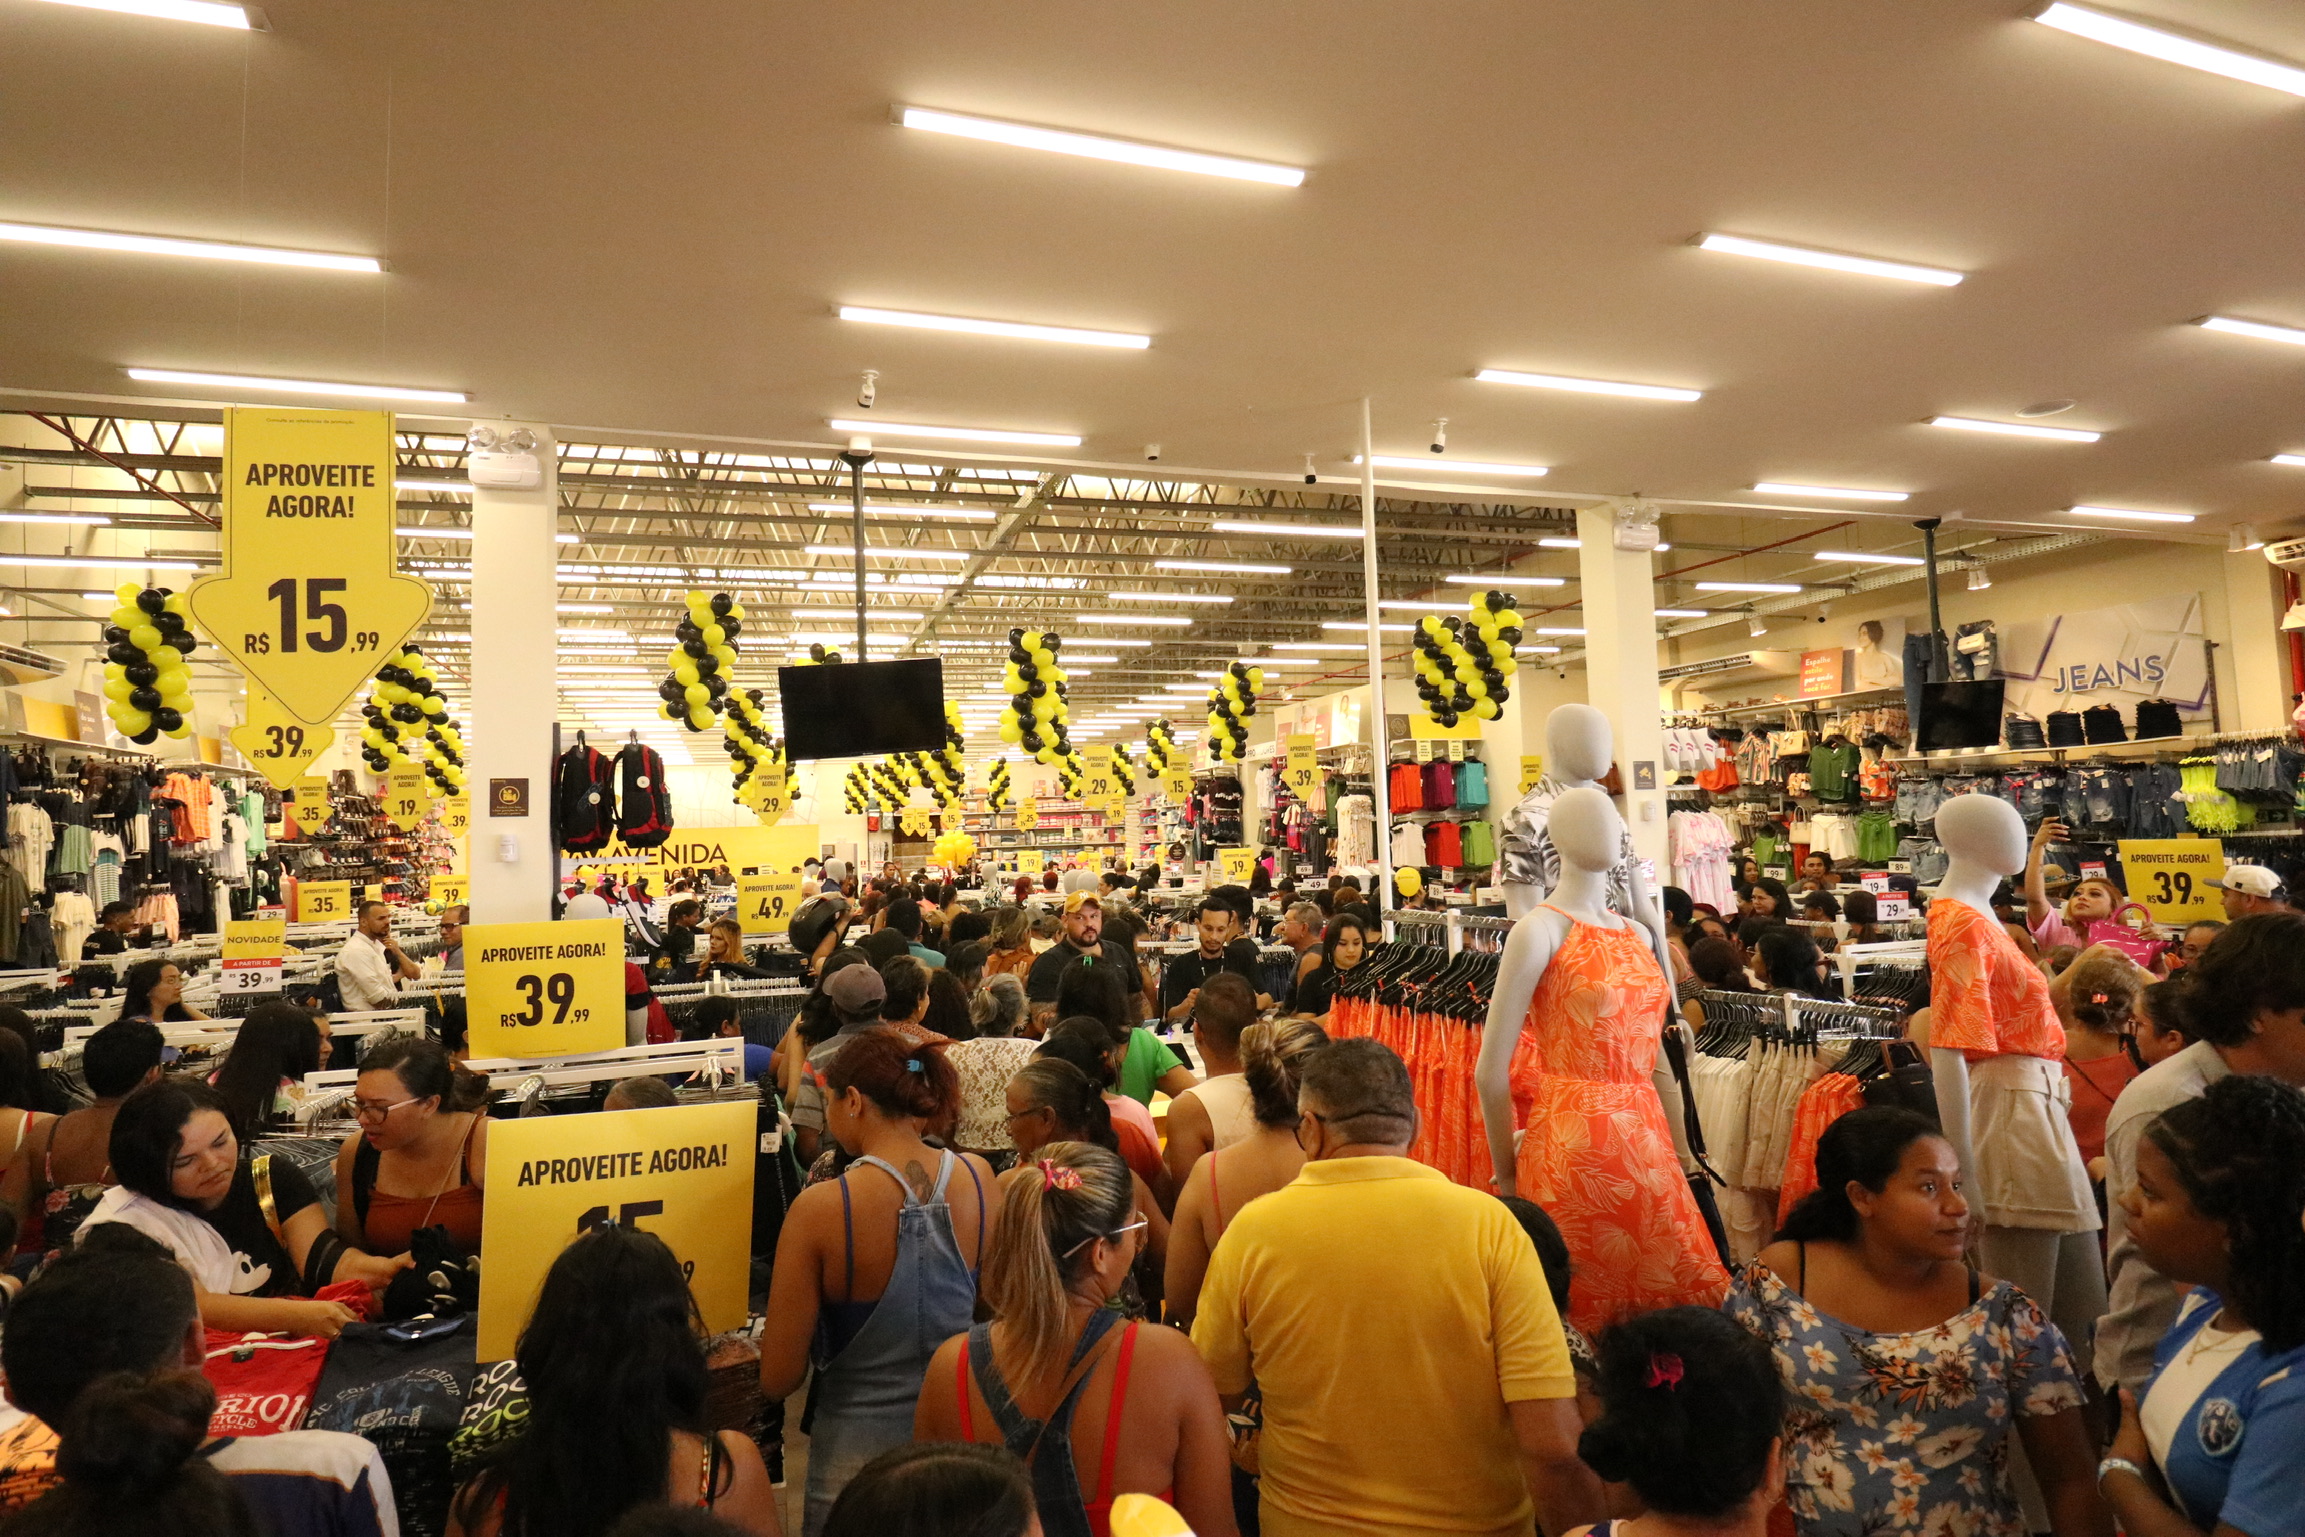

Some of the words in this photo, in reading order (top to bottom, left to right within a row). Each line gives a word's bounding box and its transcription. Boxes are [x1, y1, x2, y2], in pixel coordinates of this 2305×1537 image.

[245, 463, 375, 487] APROVEITE
[266, 495, 354, 518] AGORA!
[1804, 677, 1816, 687] por
[2053, 655, 2164, 693] JEANS
[608, 844, 728, 867] AVENIDA
[2130, 854, 2175, 864] APROVEITE
[2177, 854, 2210, 864] AGORA!
[227, 936, 280, 944] NOVIDADE
[481, 946, 553, 962] APROVEITE
[557, 943, 605, 958] AGORA!
[518, 1152, 643, 1187] APROVEITE
[648, 1144, 727, 1174] AGORA!
